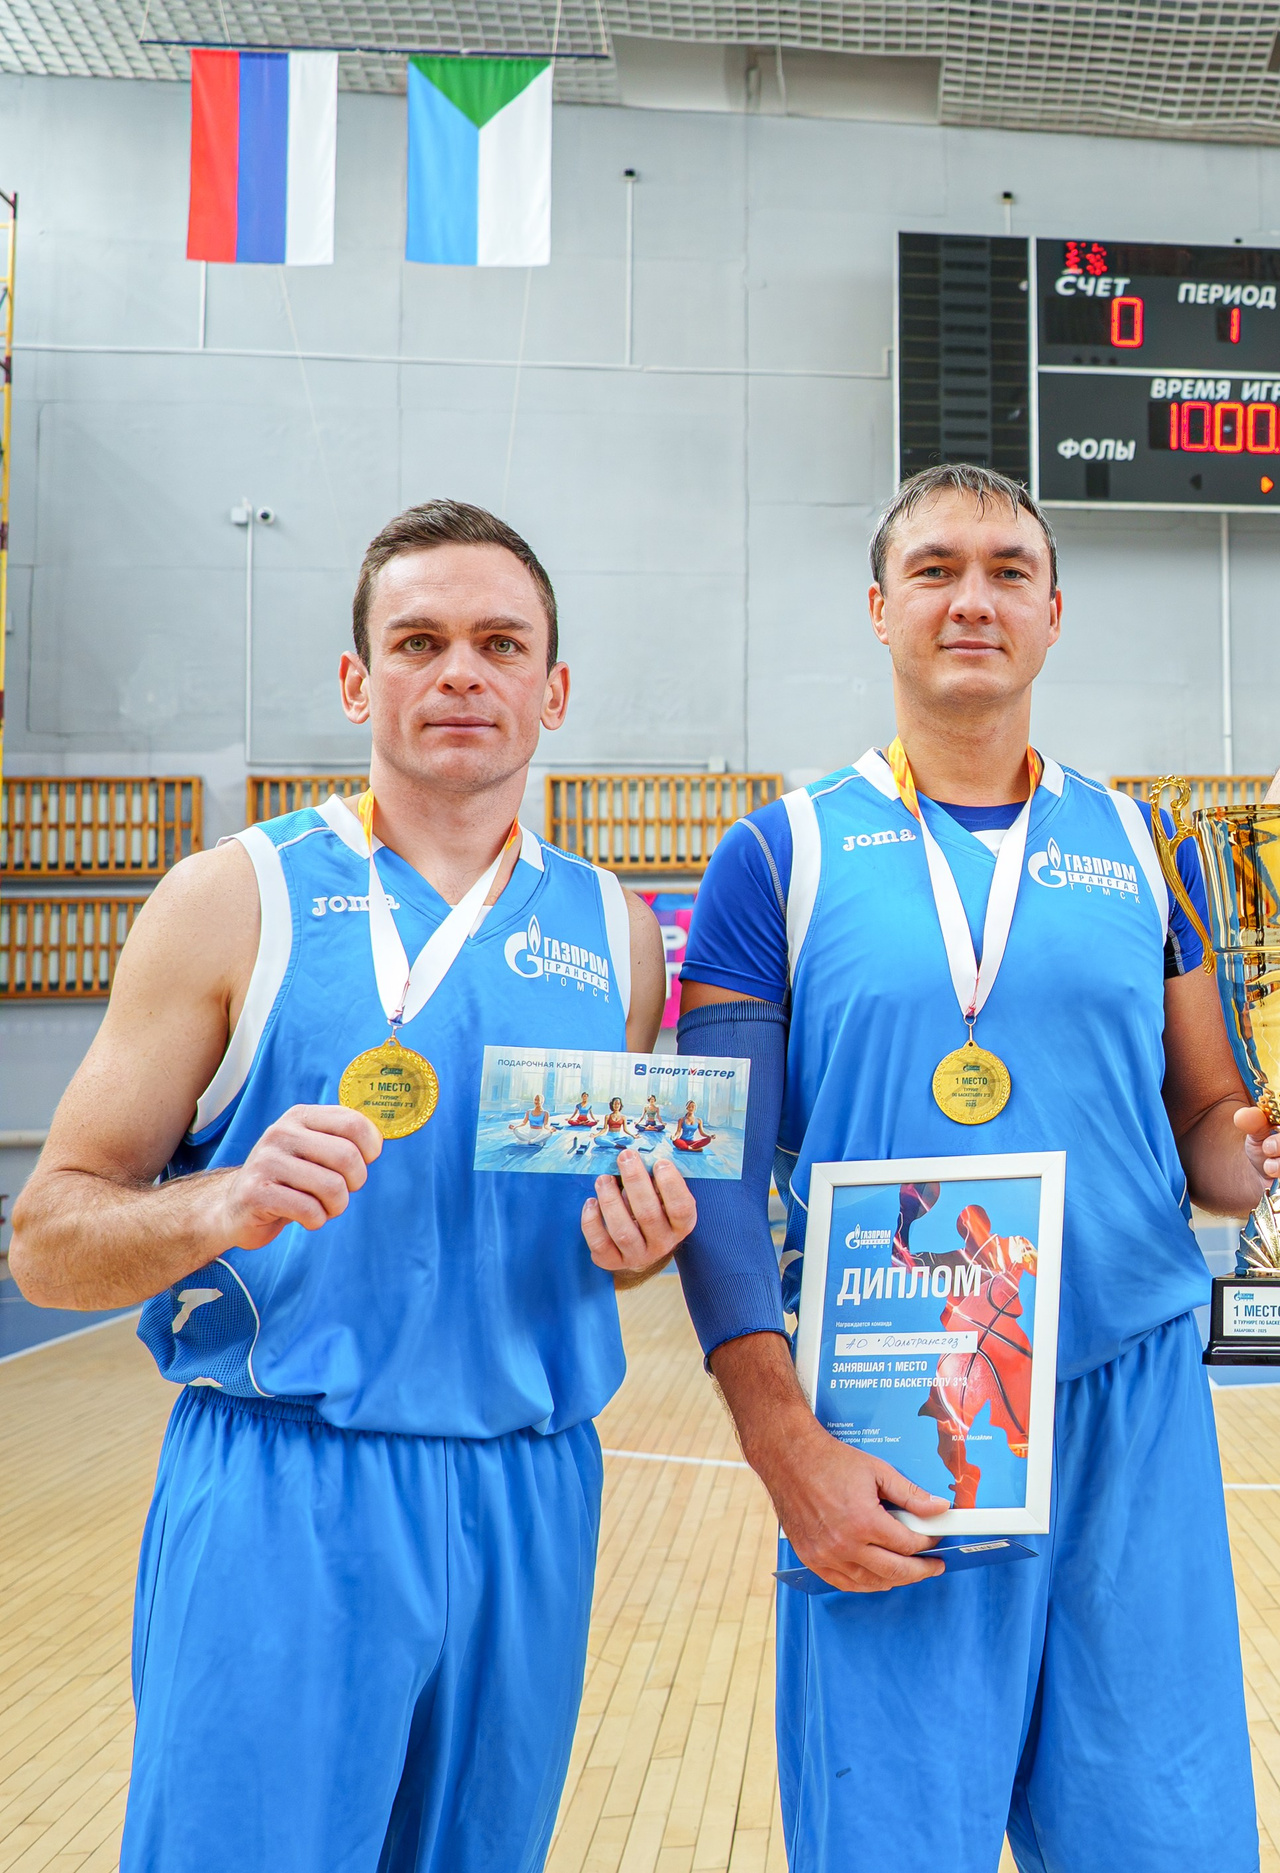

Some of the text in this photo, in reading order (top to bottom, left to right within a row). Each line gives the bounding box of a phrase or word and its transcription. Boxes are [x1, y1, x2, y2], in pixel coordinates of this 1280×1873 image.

[1055, 276, 1130, 297] СЧЕТ
[1177, 282, 1277, 309] ПЕРИОД
[1111, 296, 1144, 347] 0
[1229, 307, 1241, 344] 1
[1150, 378, 1231, 400] ВРЕМЯ
[1057, 438, 1136, 461] ФОЛЫ
[1063, 853, 1137, 883] ГАЗПРОМ
[1068, 872, 1138, 894] ТРАНСГАЗ
[1069, 882, 1141, 904] ТОМСК
[543, 936, 609, 980] ГАЗПРОМ
[544, 959, 609, 992] ТРАНСГАЗ
[544, 972, 610, 1004] ТОМСК
[497, 1059, 581, 1069] ПОДАРОЧНАЯ КАРТА
[378, 1082, 411, 1092] МЕСТО
[962, 1077, 988, 1085] МЕСТО
[861, 1229, 891, 1239] ГАЗПРОМ
[836, 1264, 982, 1306] ДИПЛОМ
[1234, 1305, 1239, 1317] 1
[832, 1360, 928, 1373] ЗАНЯВШАЯ 1 МЕСТО
[830, 1379, 837, 1389] В
[839, 1378, 878, 1389] ТУРНИРЕ
[880, 1378, 892, 1388] ПО
[894, 1377, 950, 1388] БАСКЕТБОЛУ
